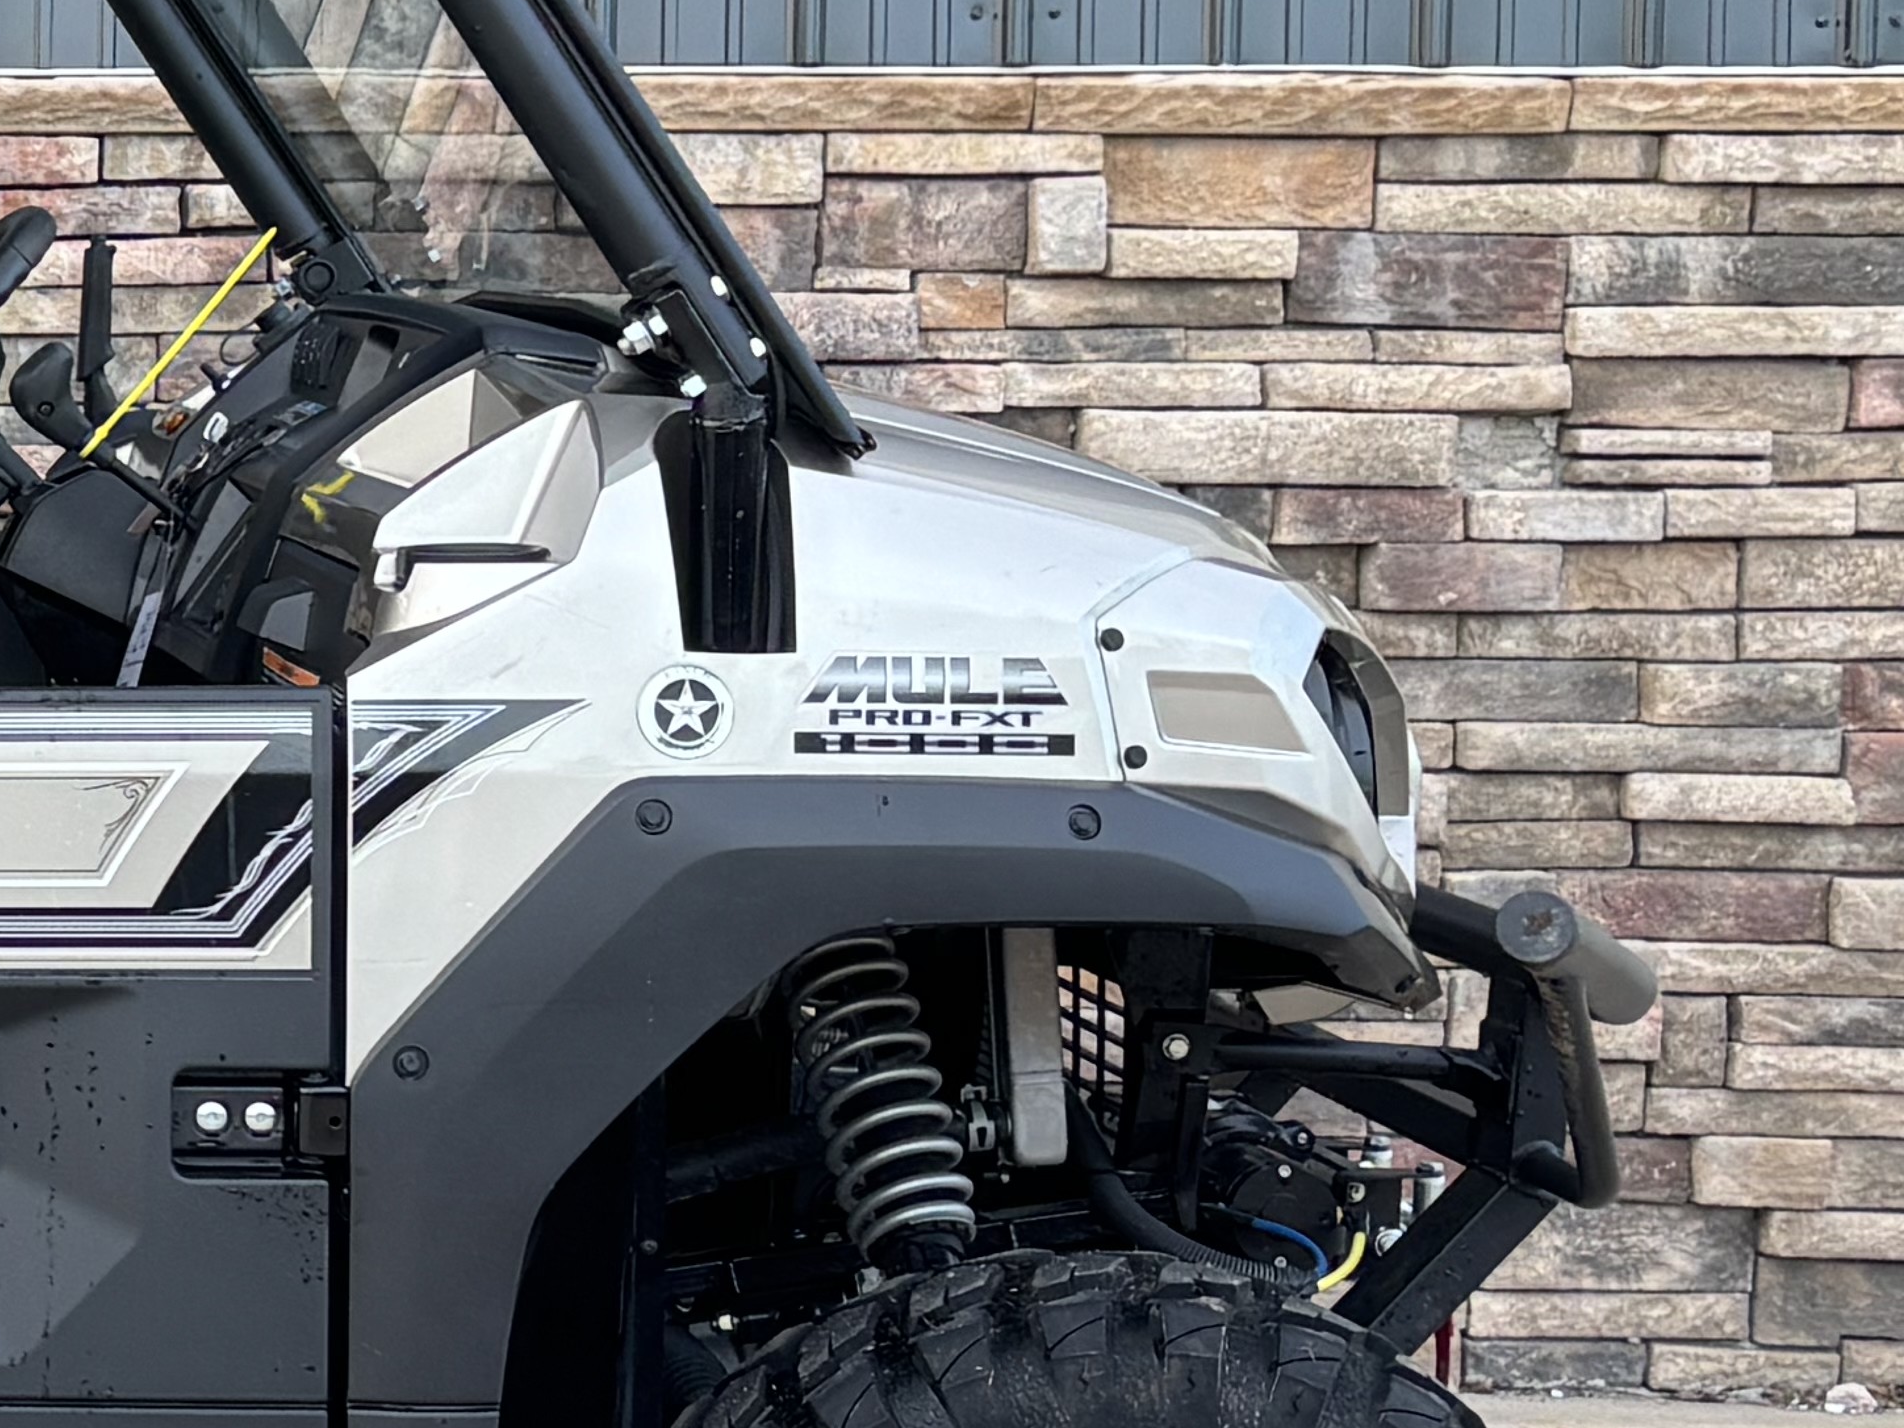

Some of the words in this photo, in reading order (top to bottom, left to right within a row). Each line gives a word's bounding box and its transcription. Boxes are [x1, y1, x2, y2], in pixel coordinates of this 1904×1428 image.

[803, 656, 1069, 706] MULE
[828, 709, 1043, 728] PRO-FXT
[819, 732, 1051, 755] 1000
